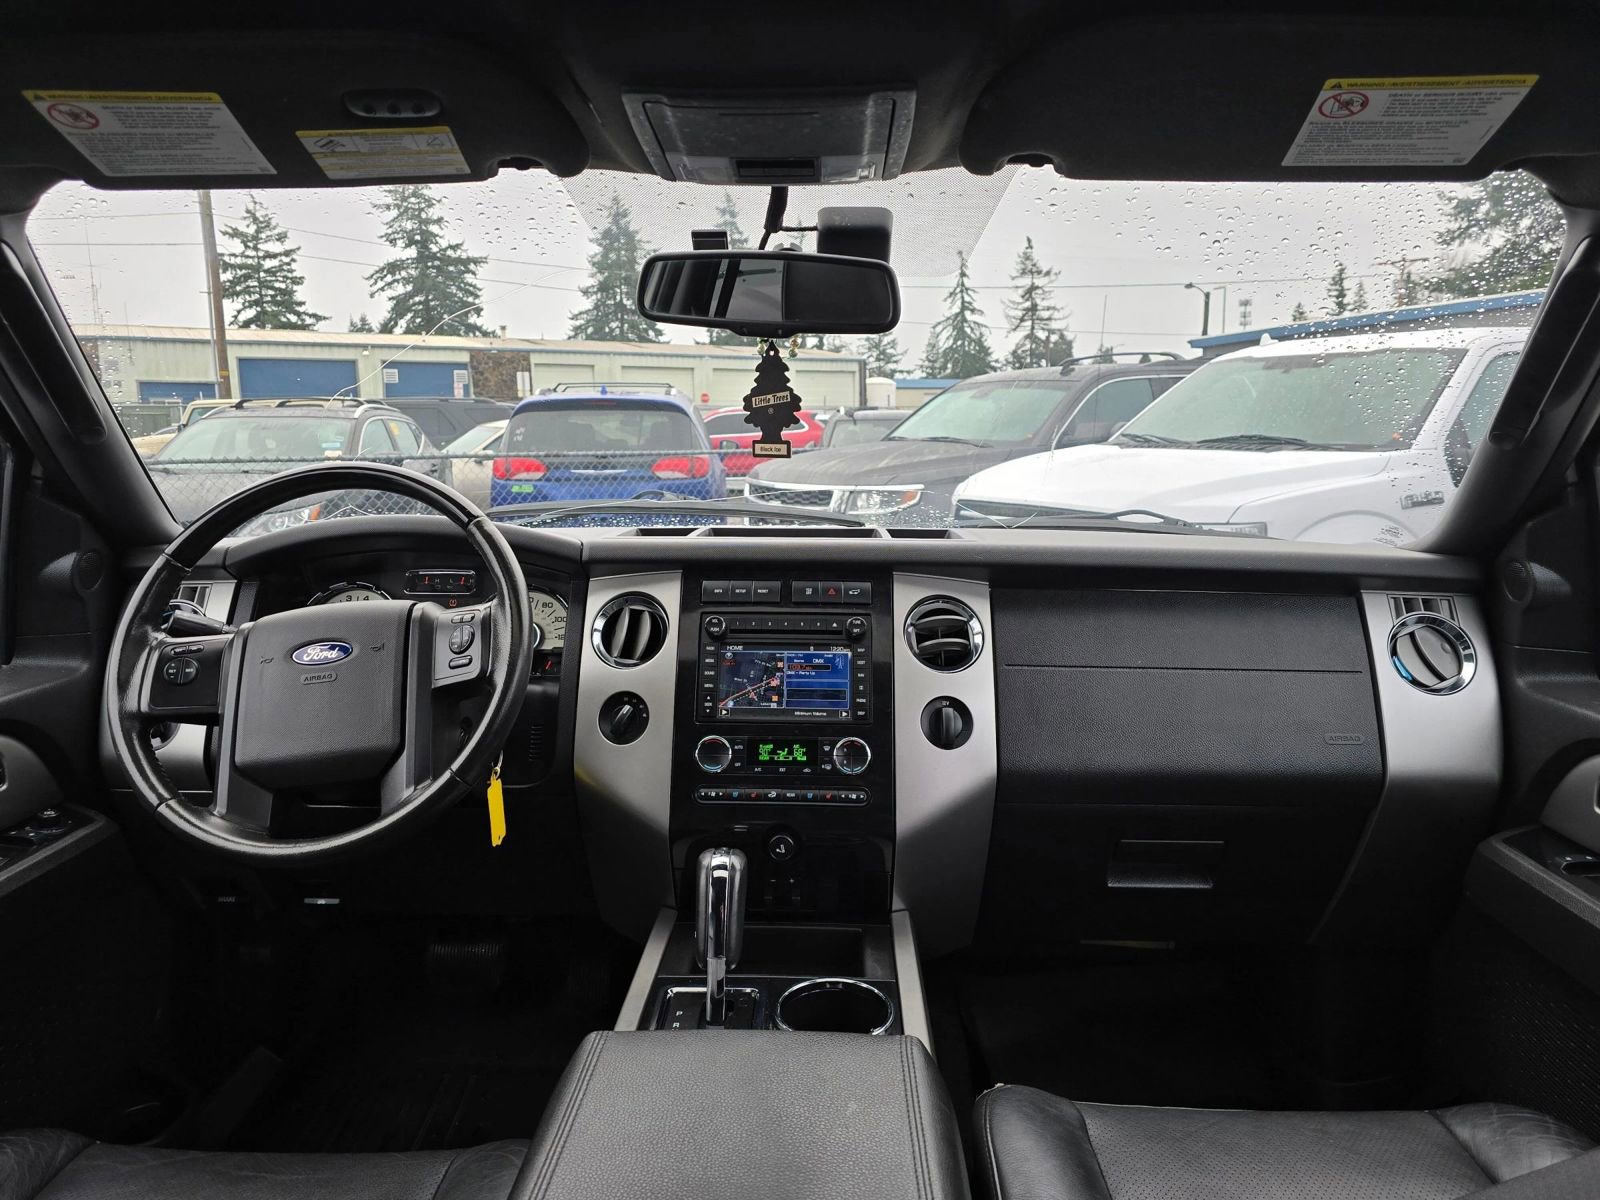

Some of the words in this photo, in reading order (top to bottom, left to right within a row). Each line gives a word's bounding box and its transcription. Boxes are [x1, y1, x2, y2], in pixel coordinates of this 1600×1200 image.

[754, 396, 771, 406] Little
[772, 394, 789, 403] Trees
[303, 645, 340, 661] Ford
[303, 673, 333, 682] AIRBAG
